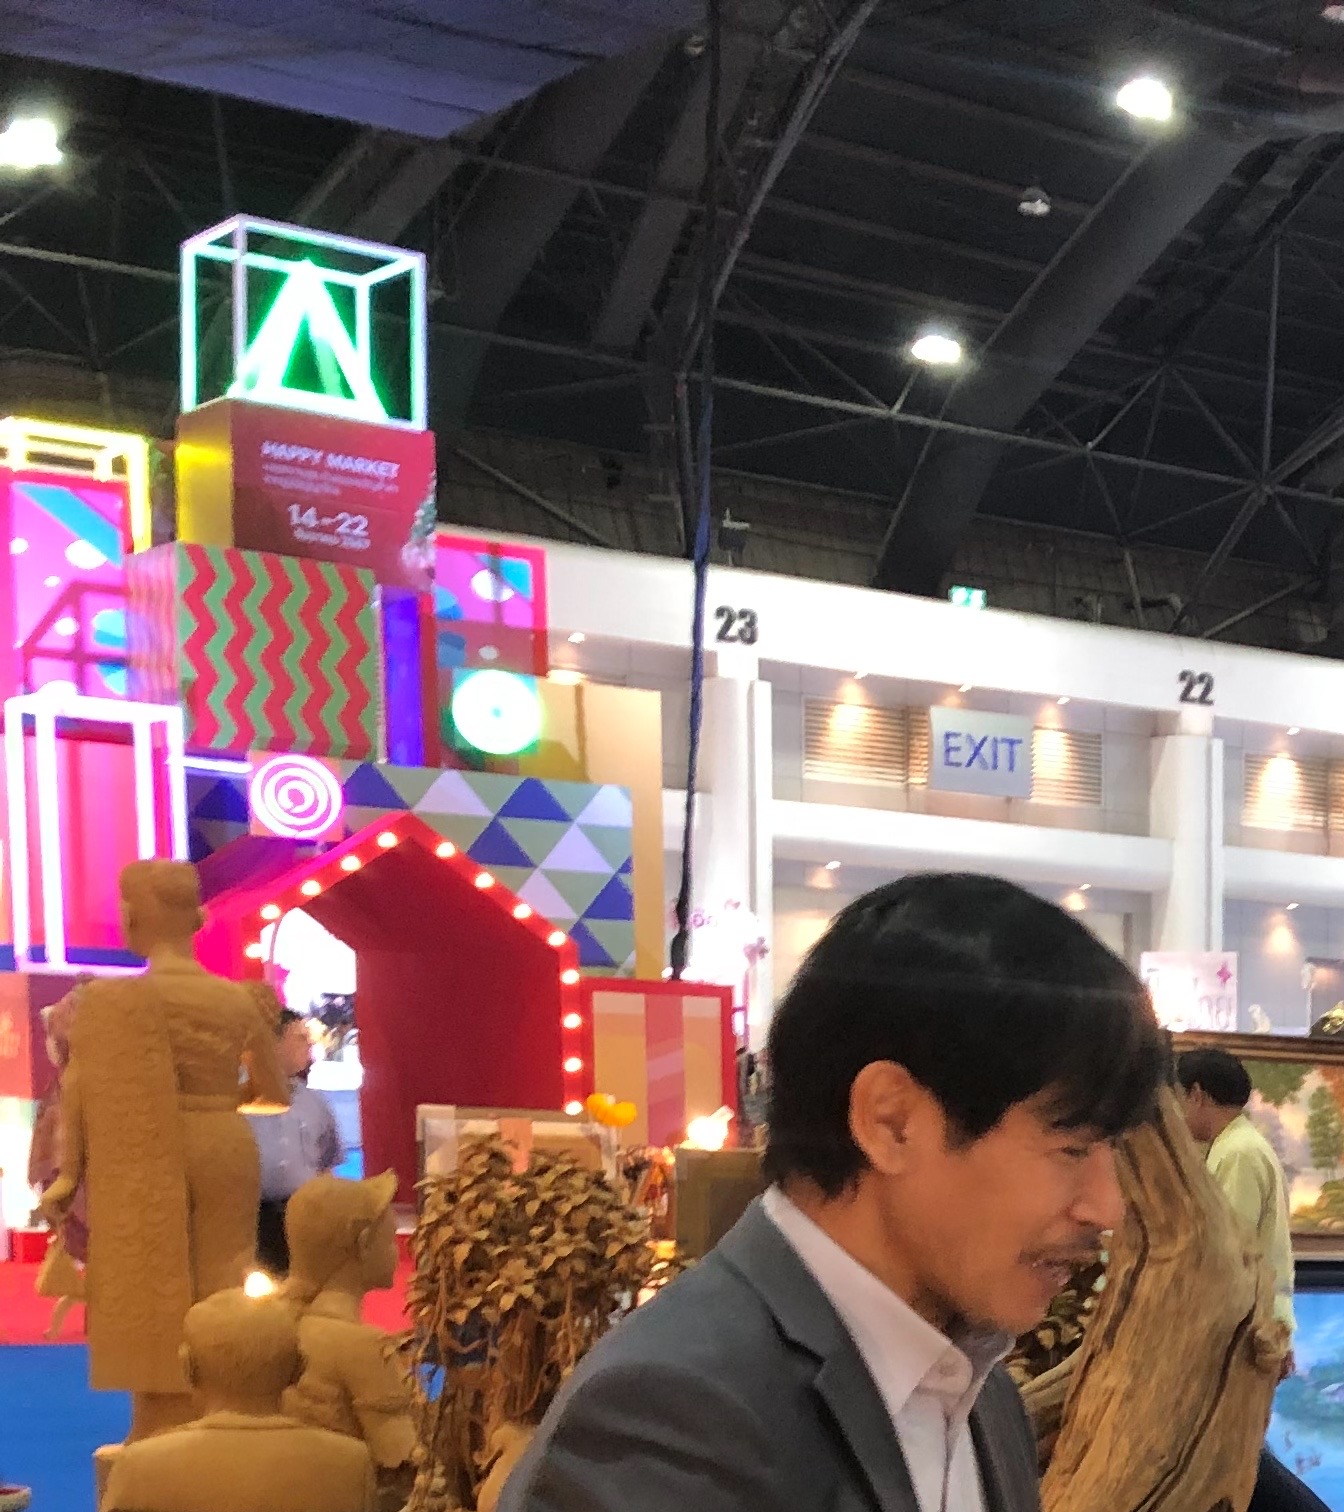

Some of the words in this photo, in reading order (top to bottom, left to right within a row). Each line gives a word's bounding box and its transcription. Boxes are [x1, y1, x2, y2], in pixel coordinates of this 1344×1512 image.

[261, 440, 324, 465] HAPPY
[326, 453, 400, 480] MARKET
[715, 605, 759, 645] 23
[1178, 669, 1215, 705] 22
[943, 730, 1023, 773] EXIT
